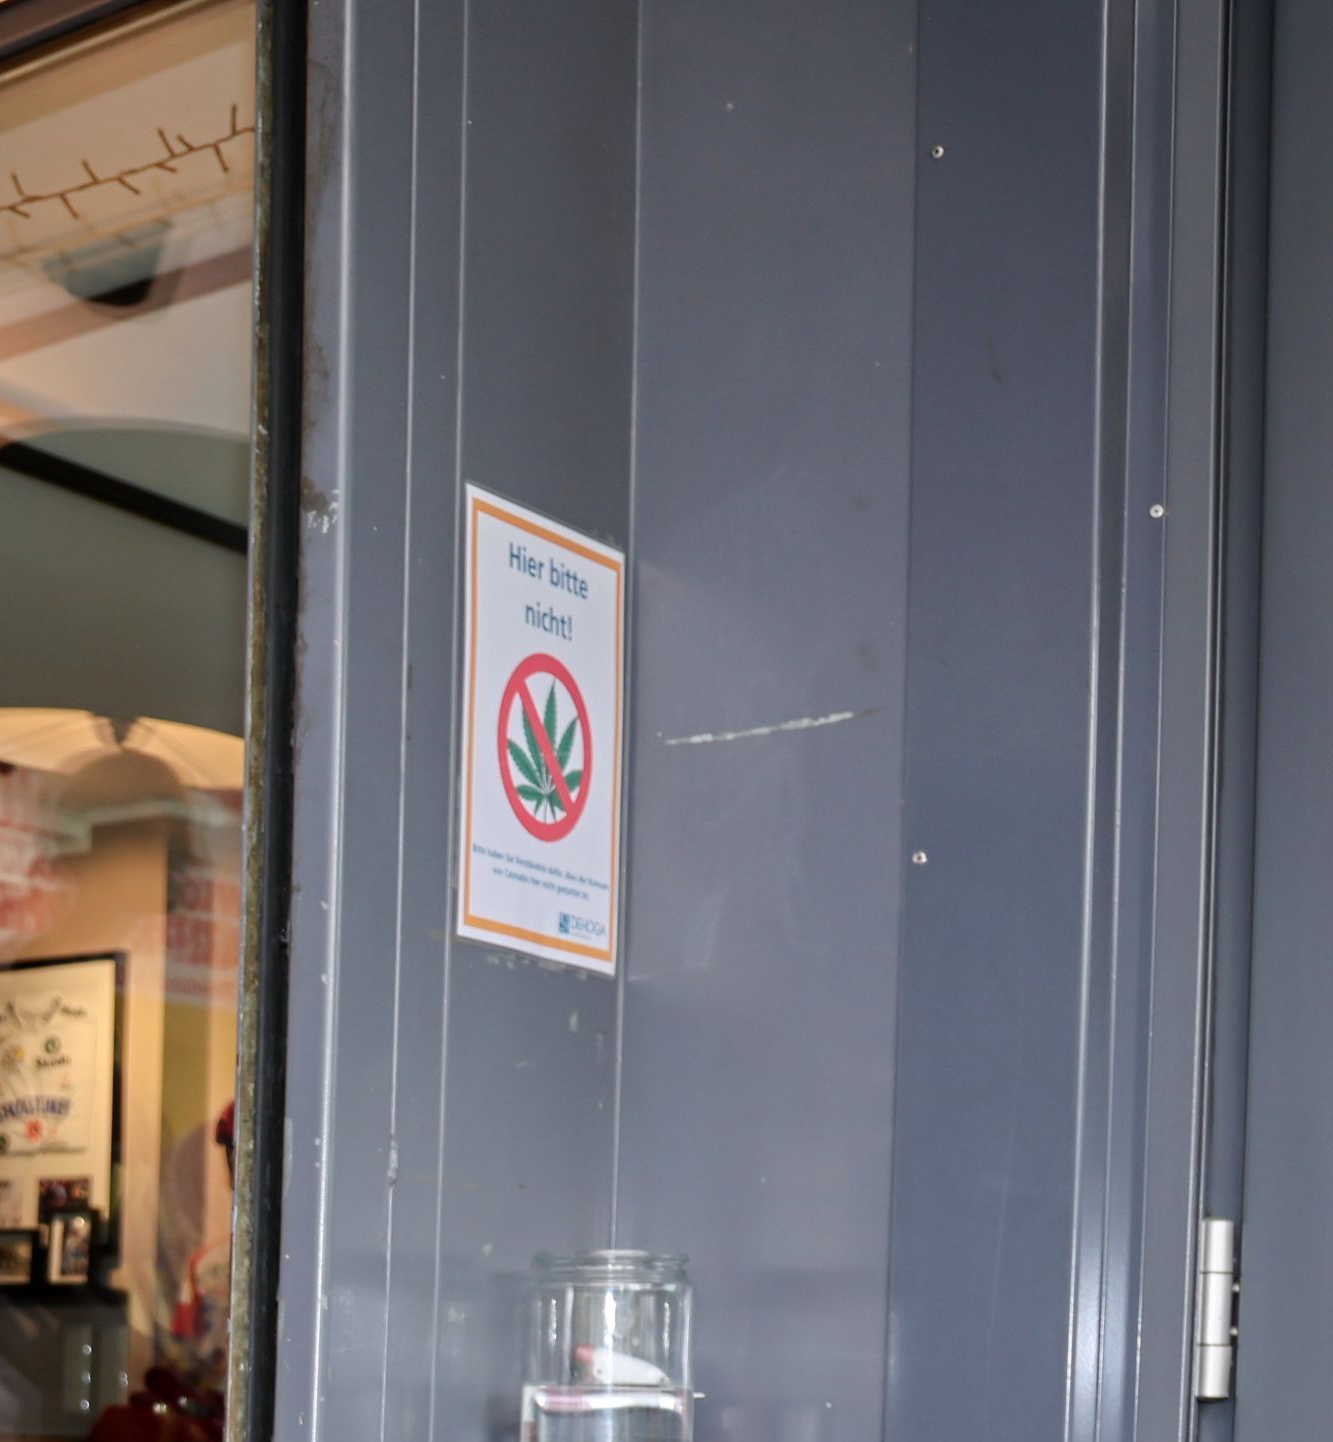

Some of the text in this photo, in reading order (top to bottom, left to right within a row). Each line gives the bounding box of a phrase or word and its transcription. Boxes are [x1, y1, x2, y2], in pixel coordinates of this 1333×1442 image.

[509, 542, 588, 599] Hier bitte
[525, 601, 572, 641] nicht!
